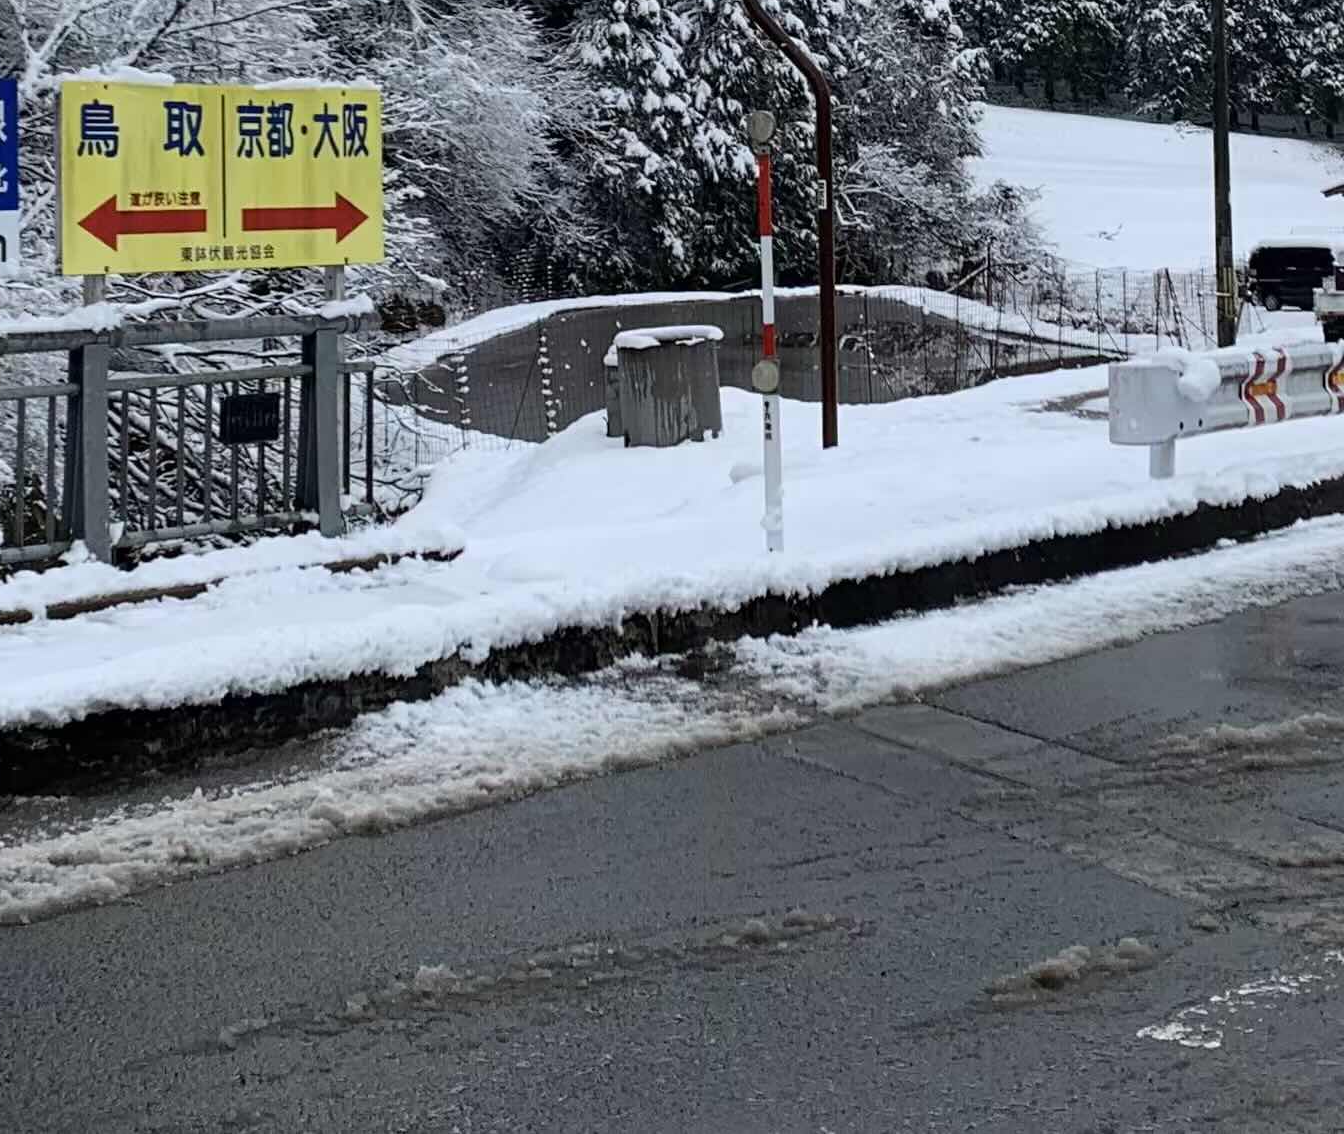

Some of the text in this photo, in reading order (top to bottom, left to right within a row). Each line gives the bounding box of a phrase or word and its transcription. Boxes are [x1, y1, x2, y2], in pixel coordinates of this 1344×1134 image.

[236, 100, 369, 158] 京都・大阪
[129, 192, 201, 207] 道が狭い注意
